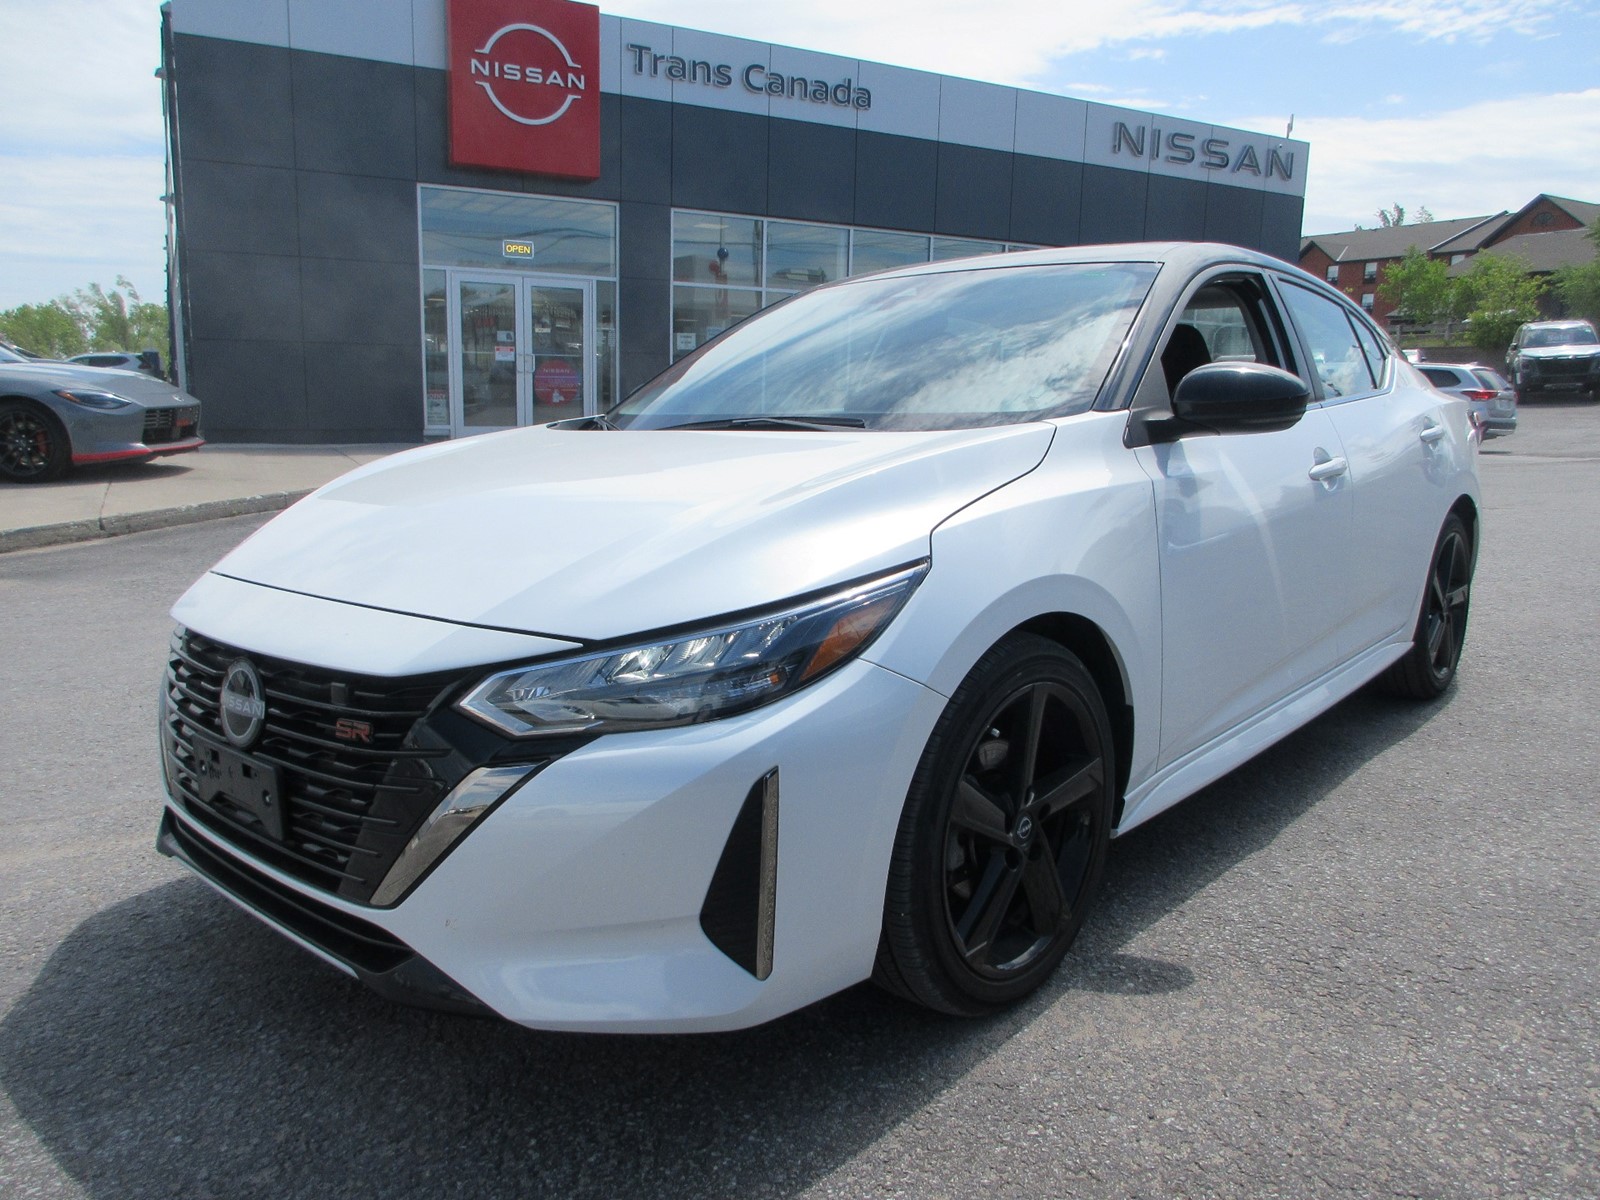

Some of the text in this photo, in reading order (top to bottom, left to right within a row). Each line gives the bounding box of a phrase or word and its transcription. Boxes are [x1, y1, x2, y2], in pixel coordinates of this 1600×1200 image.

[471, 58, 585, 90] NISSAN
[627, 43, 873, 111] Trans Canada
[1112, 121, 1295, 181] NISSAN
[505, 244, 531, 254] OPEN
[335, 718, 370, 742] SR
